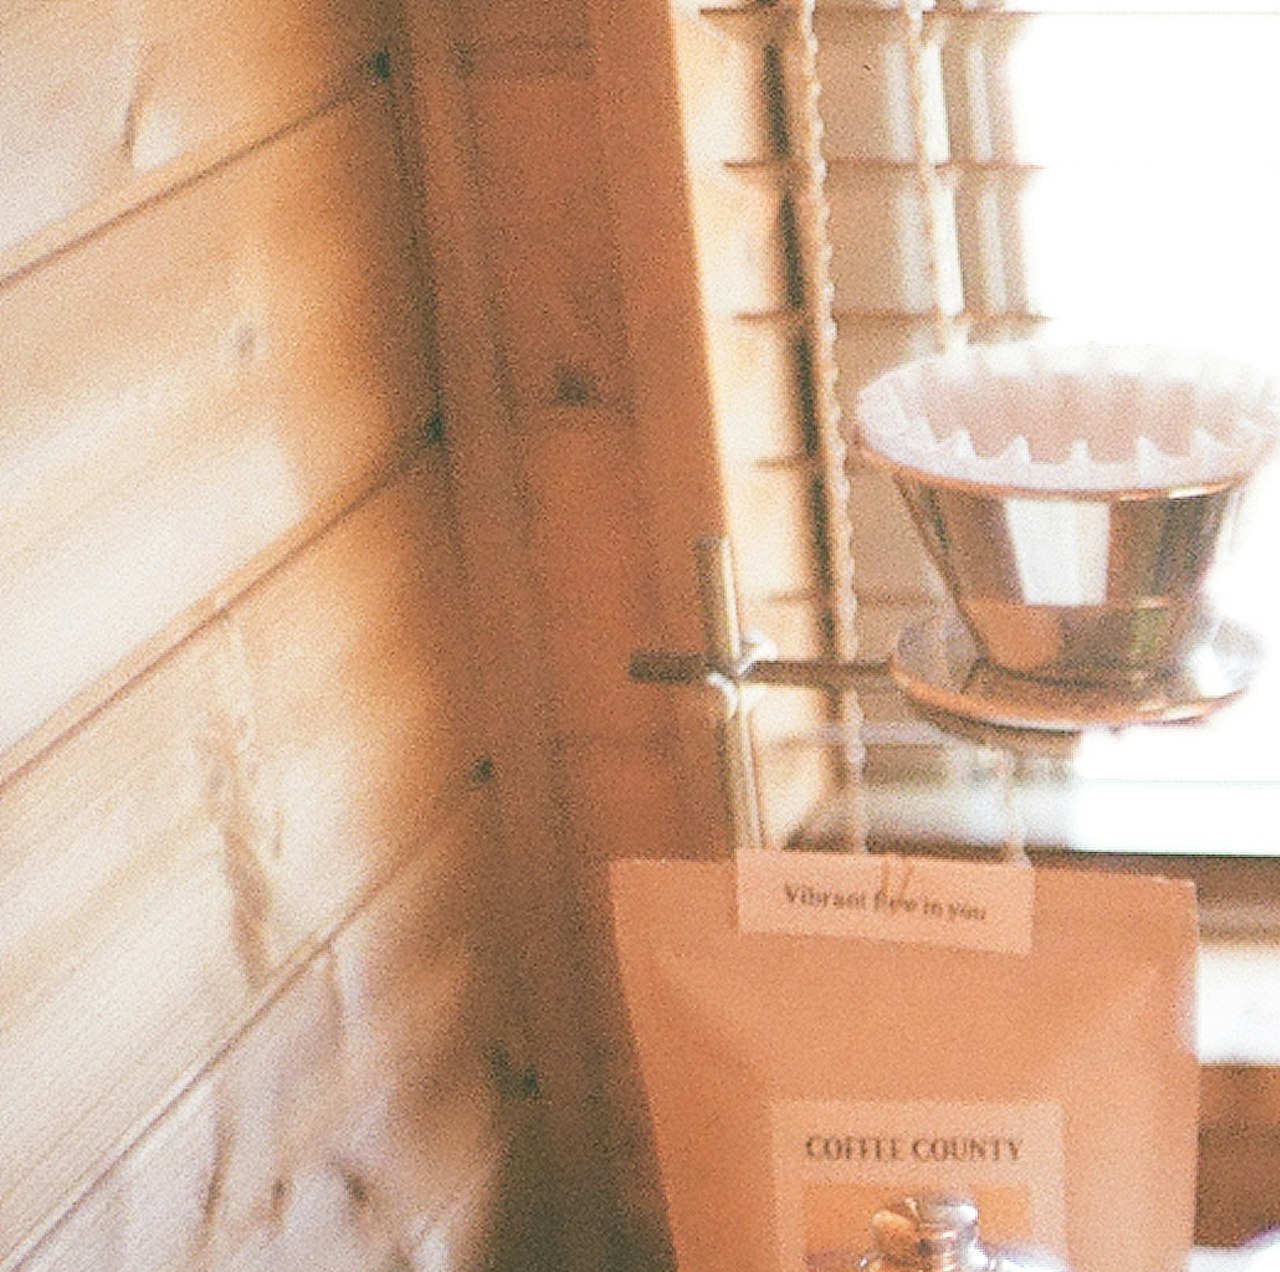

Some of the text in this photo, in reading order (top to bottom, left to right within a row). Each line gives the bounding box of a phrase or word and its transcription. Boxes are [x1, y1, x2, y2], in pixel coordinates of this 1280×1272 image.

[784, 882, 866, 909] Vibrant
[948, 903, 987, 922] you
[804, 1134, 1023, 1162] COFFEE COUNTY
